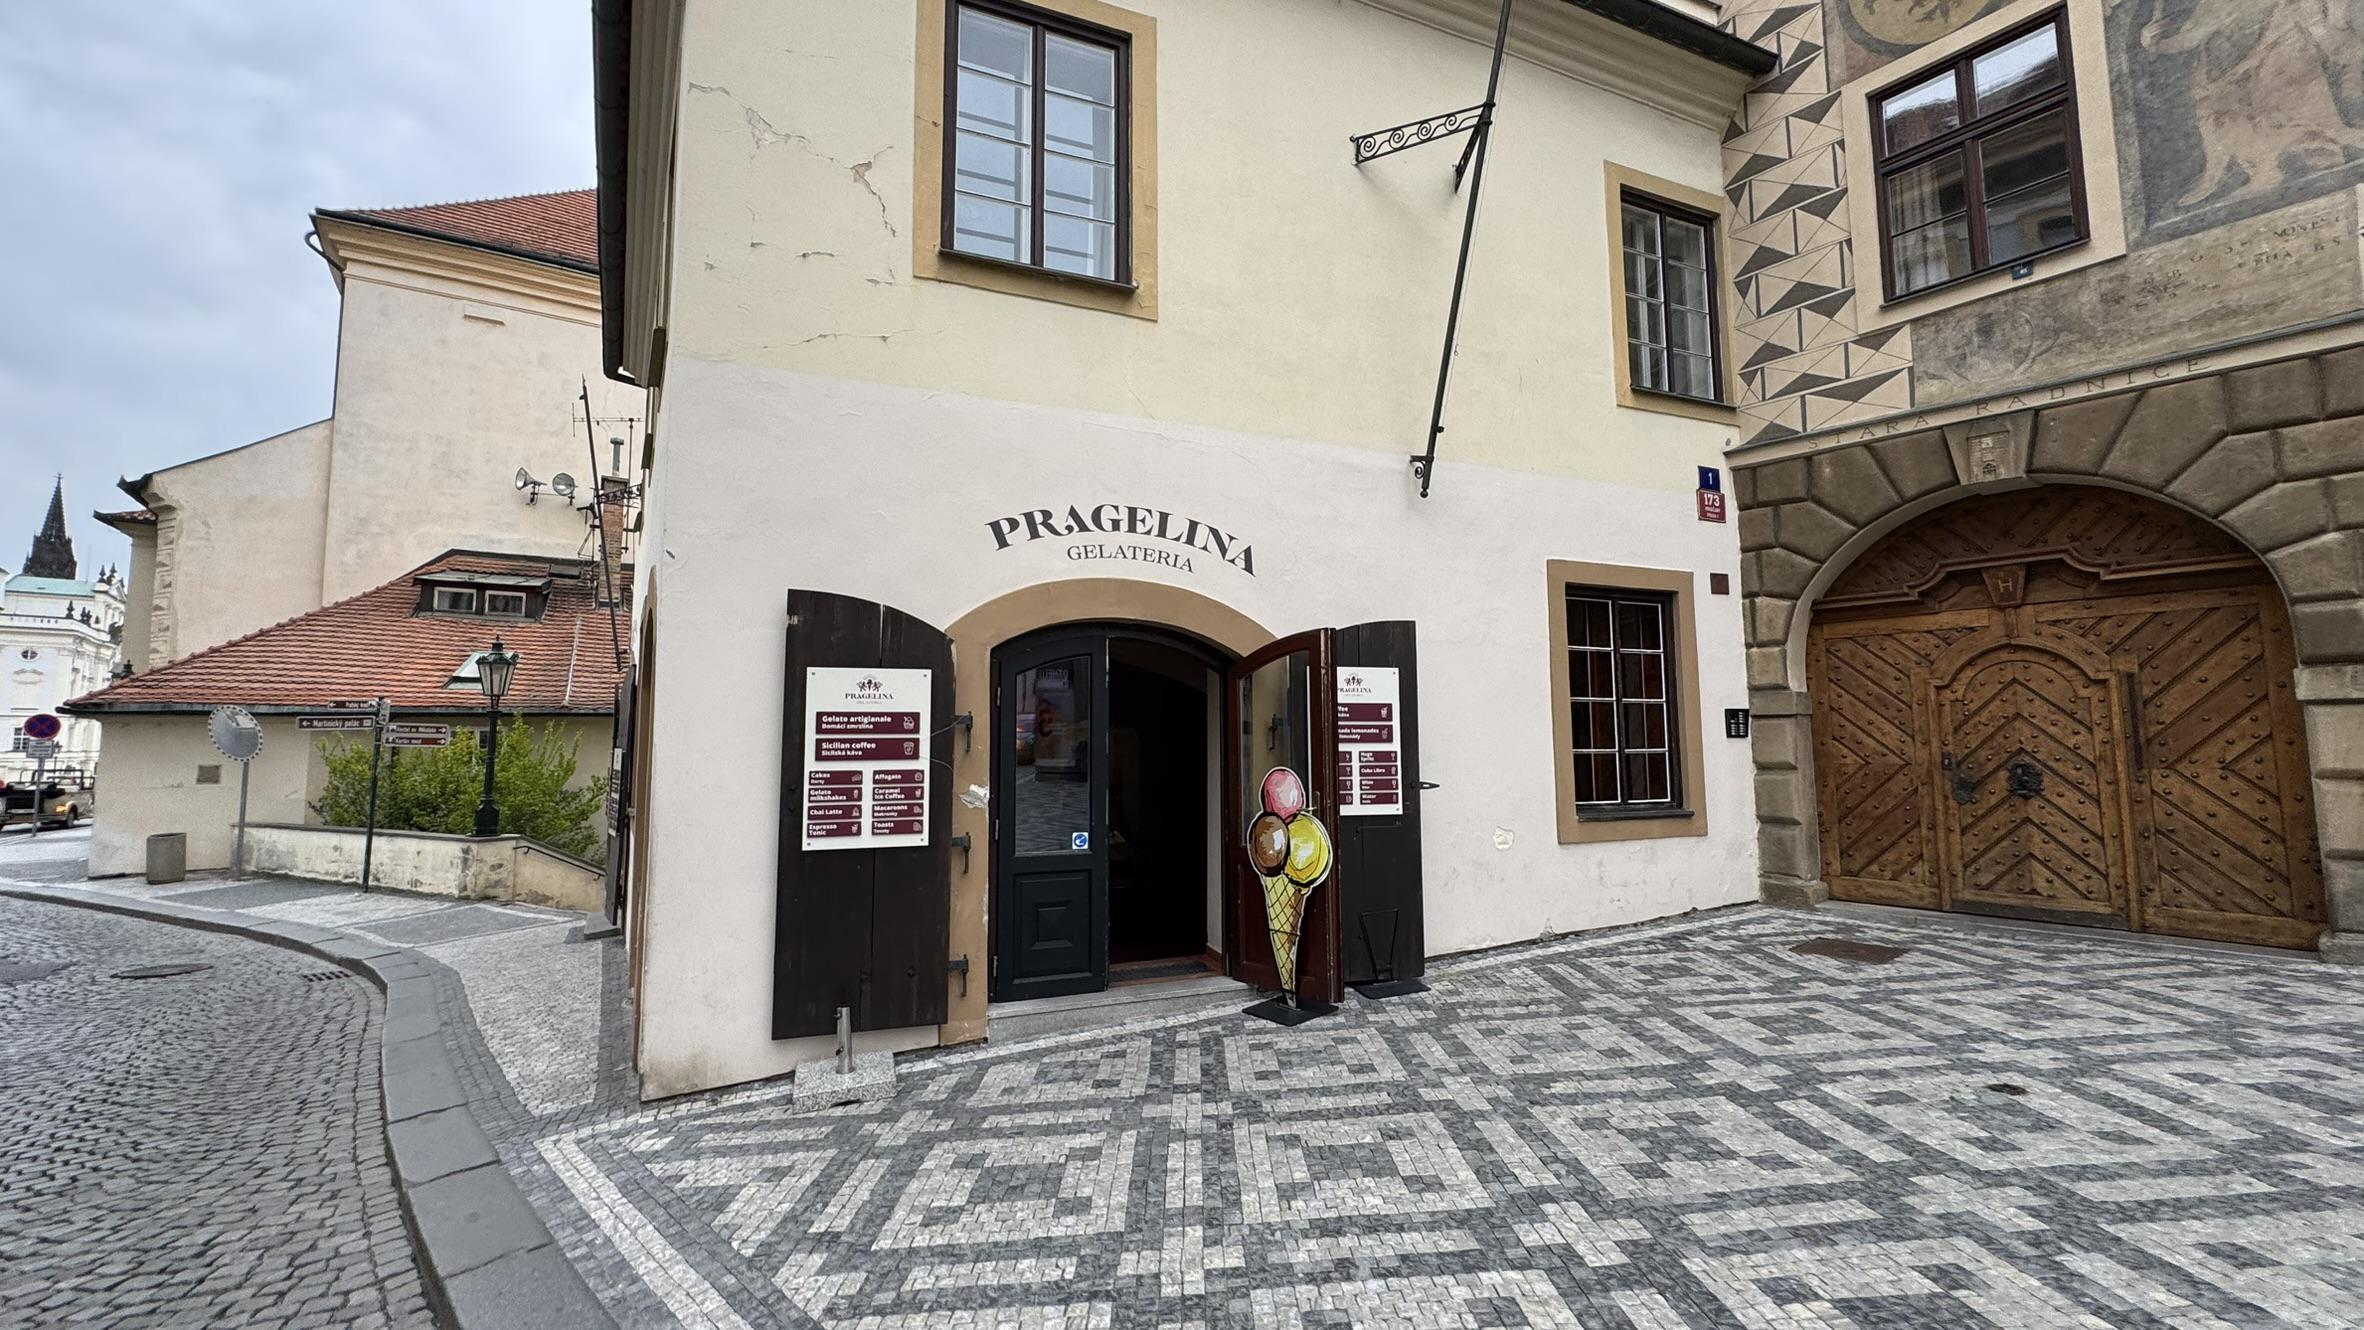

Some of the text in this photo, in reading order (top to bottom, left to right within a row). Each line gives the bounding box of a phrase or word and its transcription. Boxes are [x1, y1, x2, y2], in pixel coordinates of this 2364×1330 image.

[1975, 358, 2210, 415] RADNICE
[1708, 472, 1712, 485] 1
[1703, 493, 1720, 507] 173
[983, 503, 1257, 578] PRAGELINA
[1066, 543, 1195, 574] GELATERIA
[312, 718, 343, 728] Martinický
[849, 715, 892, 724] artigianale
